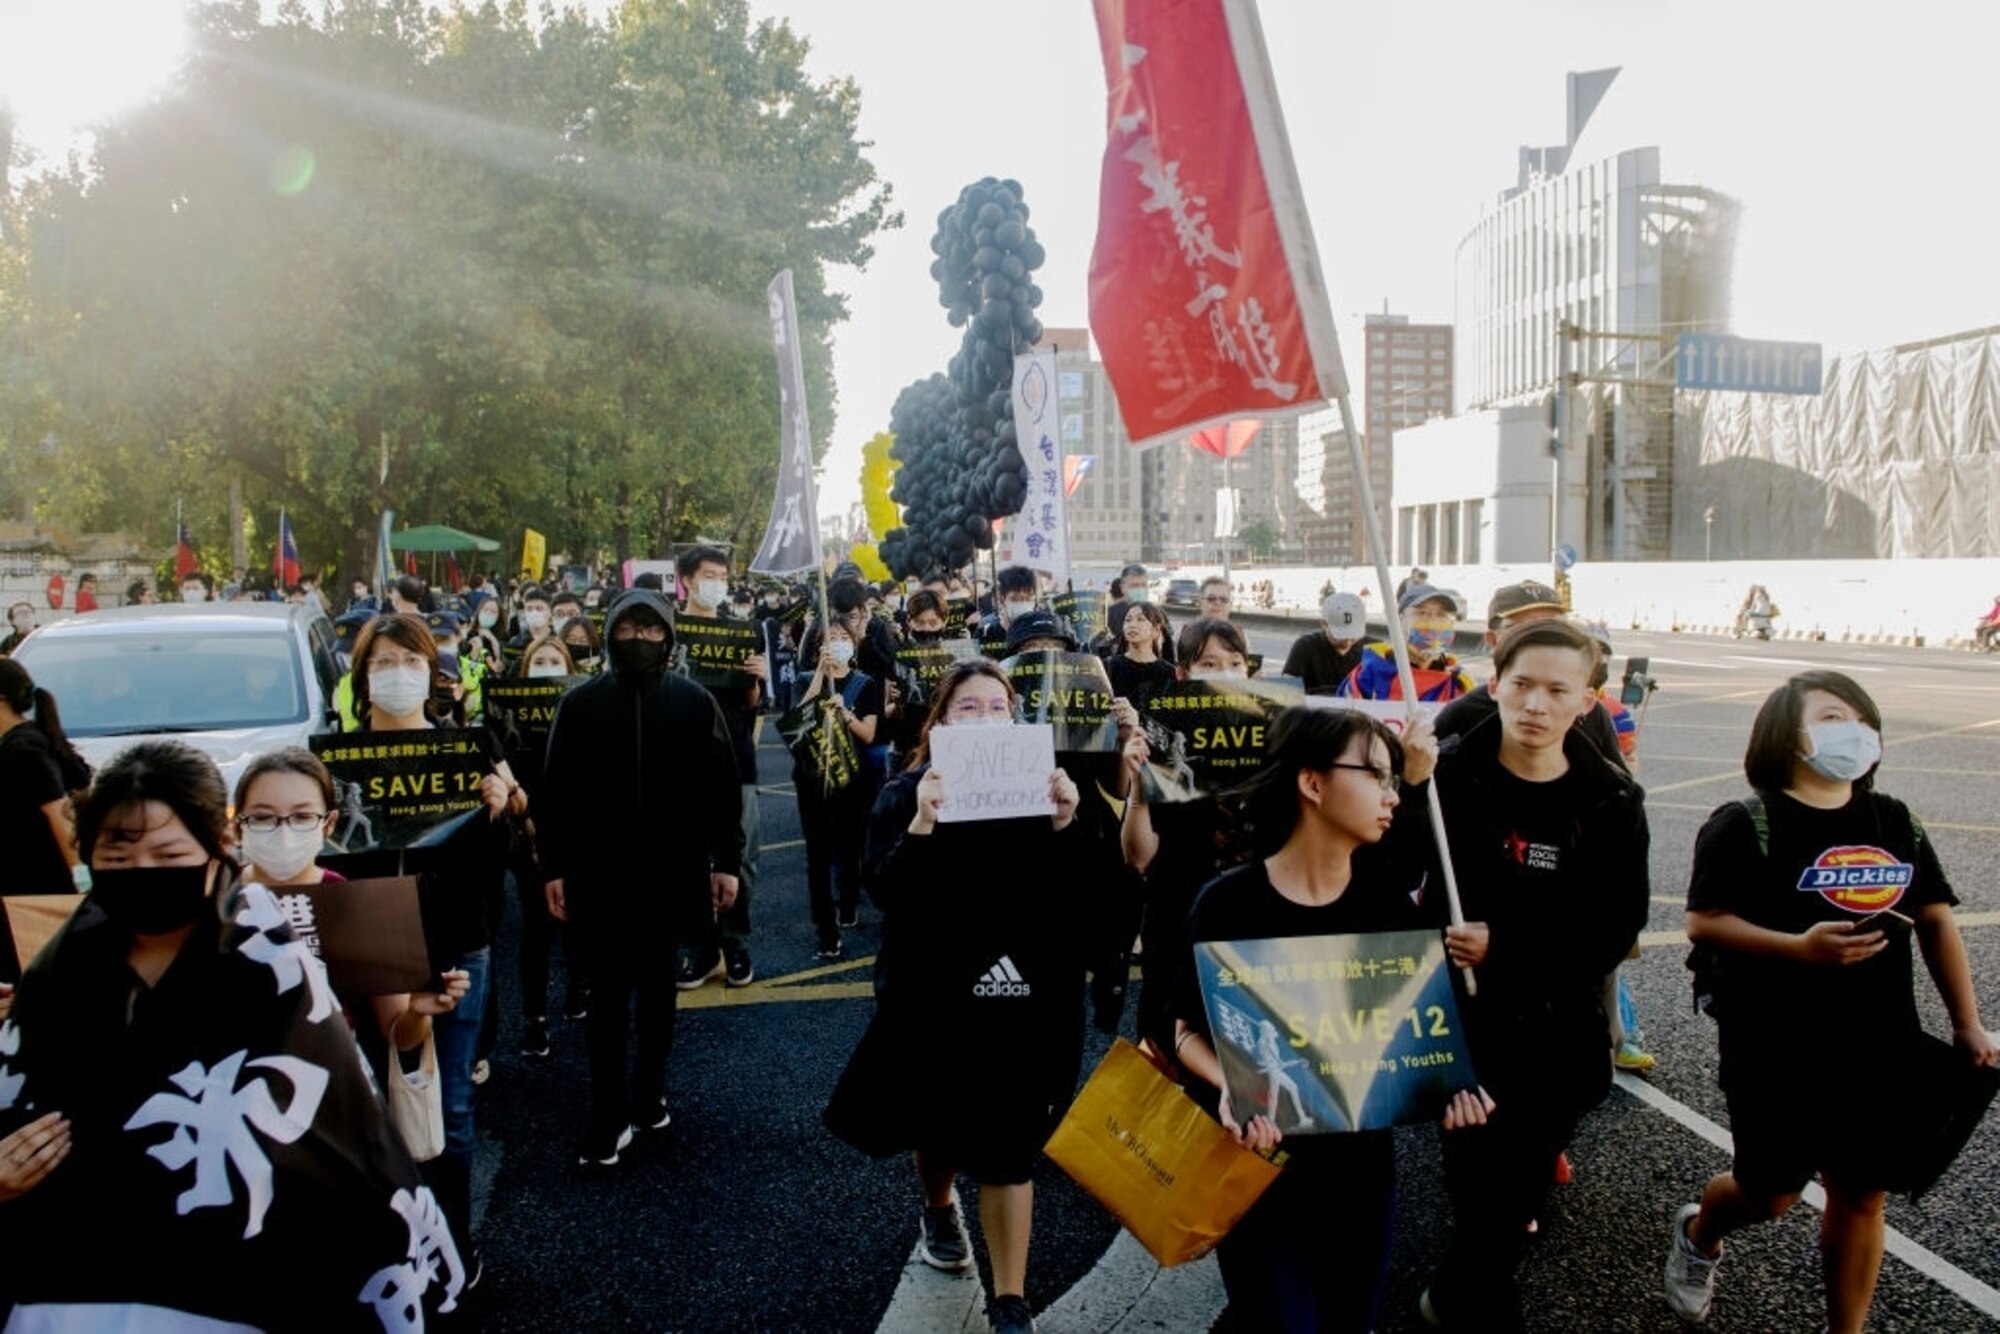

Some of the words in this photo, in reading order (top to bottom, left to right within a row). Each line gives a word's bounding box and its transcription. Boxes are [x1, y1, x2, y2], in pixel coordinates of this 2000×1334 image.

[1344, 612, 1353, 624] D
[691, 643, 735, 659] SAVE
[1030, 689, 1085, 708] SAVE
[1090, 692, 1110, 710] 12
[518, 706, 556, 722] SAV
[1193, 725, 1265, 749] SAVE
[369, 772, 445, 799] SAVE
[454, 772, 481, 792] 12
[390, 805, 416, 816] Hong
[419, 803, 444, 814] Kong
[1813, 868, 1907, 886] Dickies
[972, 981, 1031, 997] adidas
[1289, 1008, 1393, 1048] SAVE
[1406, 1005, 1450, 1039] 12
[1401, 1051, 1454, 1068] Youths
